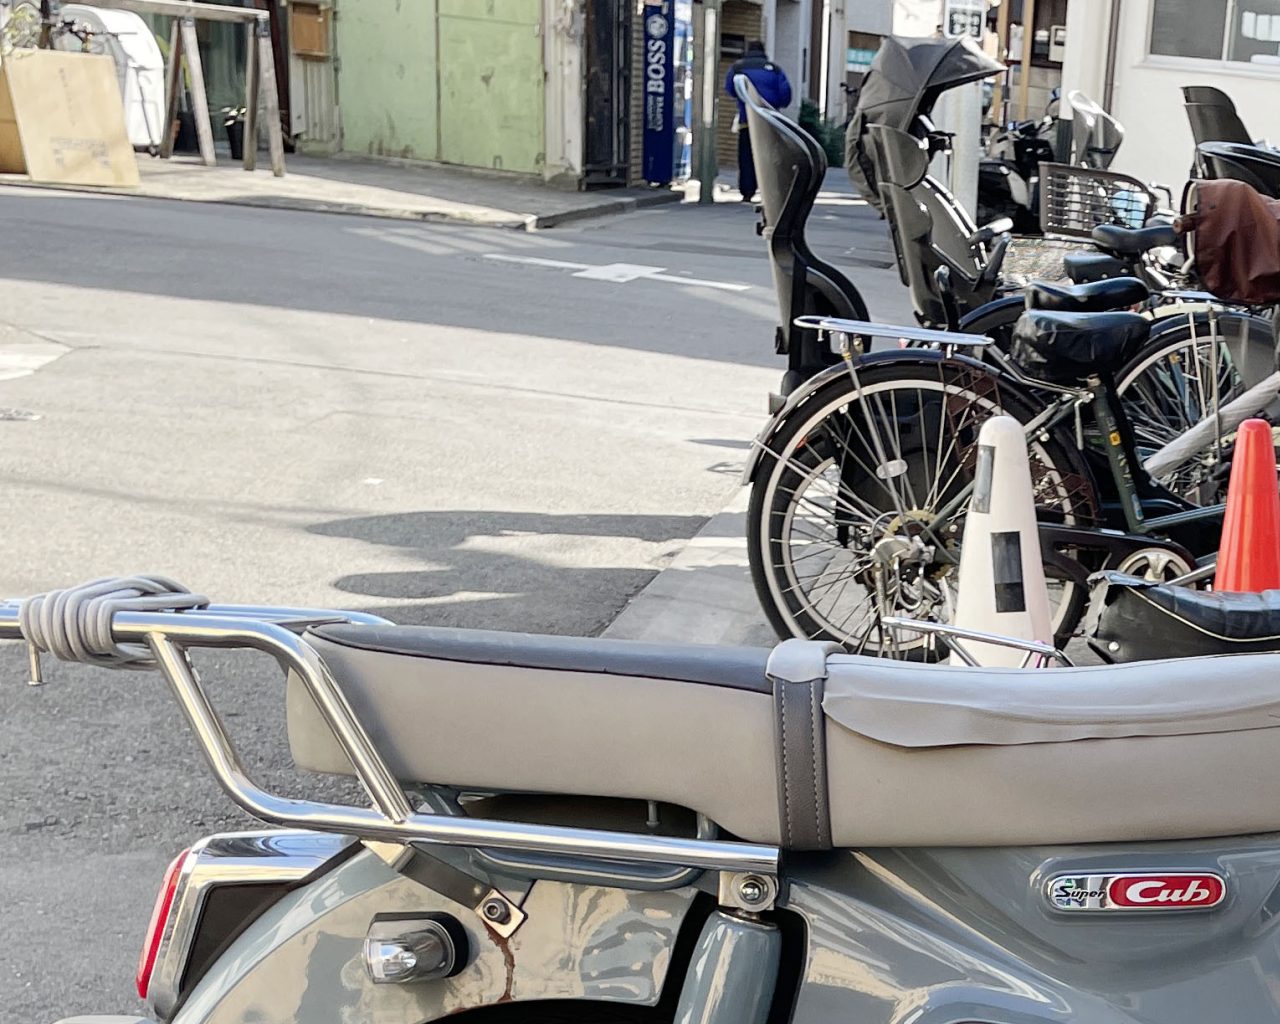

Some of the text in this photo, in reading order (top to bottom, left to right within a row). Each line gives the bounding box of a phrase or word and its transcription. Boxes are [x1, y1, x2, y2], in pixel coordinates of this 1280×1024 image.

[647, 40, 666, 93] BOSS
[1055, 880, 1209, 903] Super Cub
